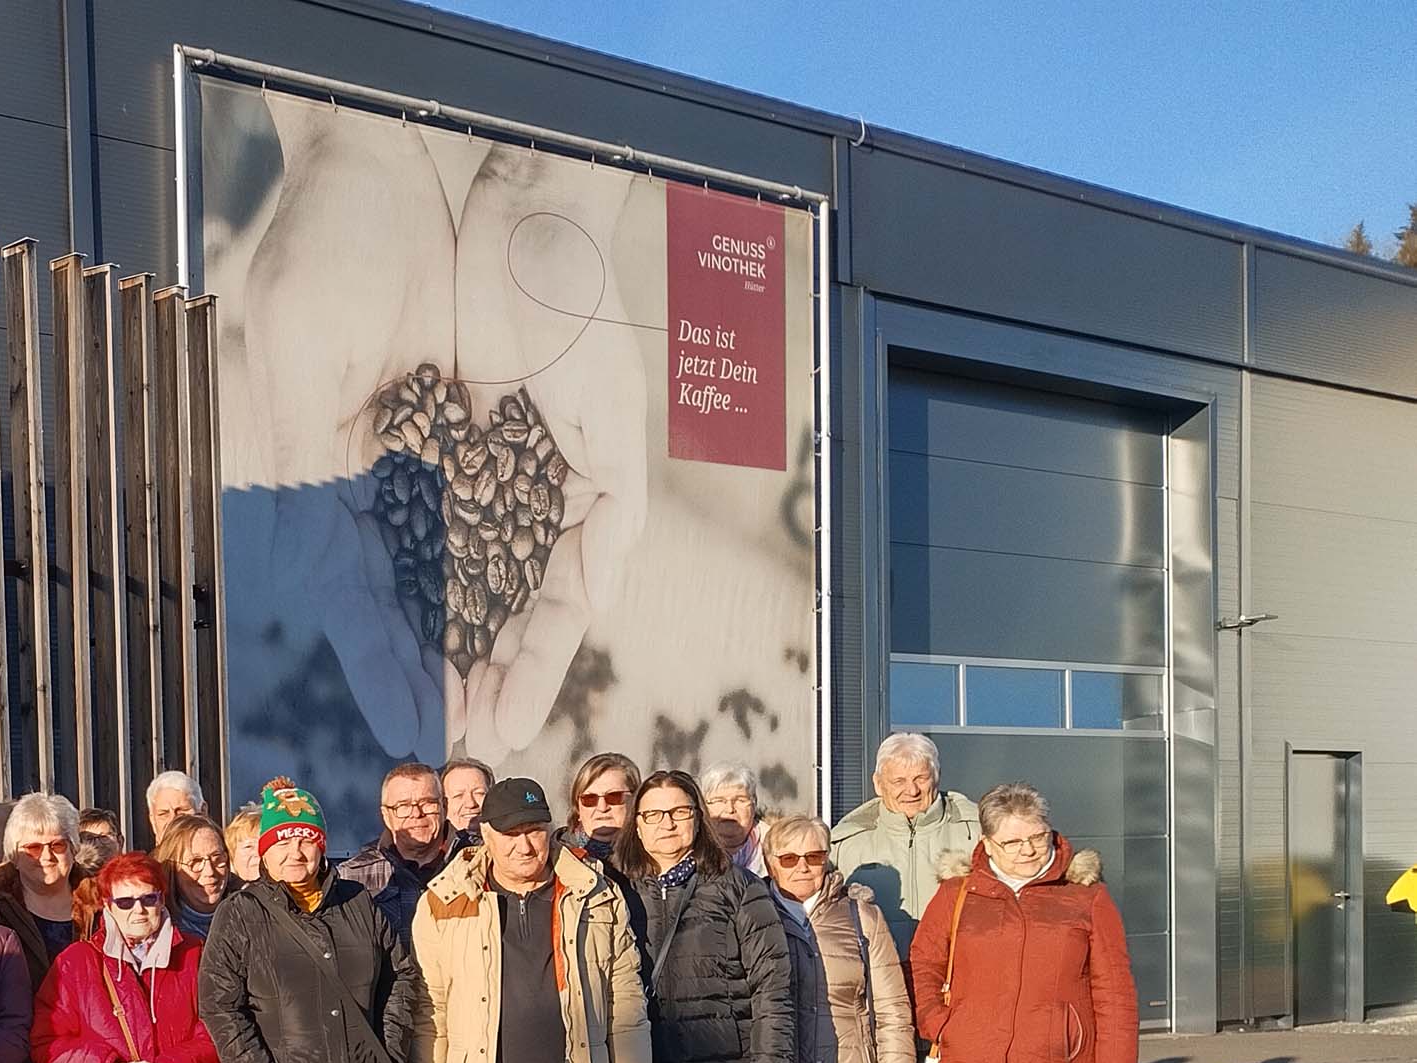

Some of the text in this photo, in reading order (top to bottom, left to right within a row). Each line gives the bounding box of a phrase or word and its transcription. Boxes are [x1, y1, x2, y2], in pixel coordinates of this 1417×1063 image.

[712, 234, 766, 260] GENUSS
[697, 250, 766, 279] VINOTHEK
[678, 319, 736, 350] Das ist
[675, 349, 758, 384] jetzt Dein
[677, 382, 731, 414] Kaffee
[276, 827, 319, 840] MERRY
